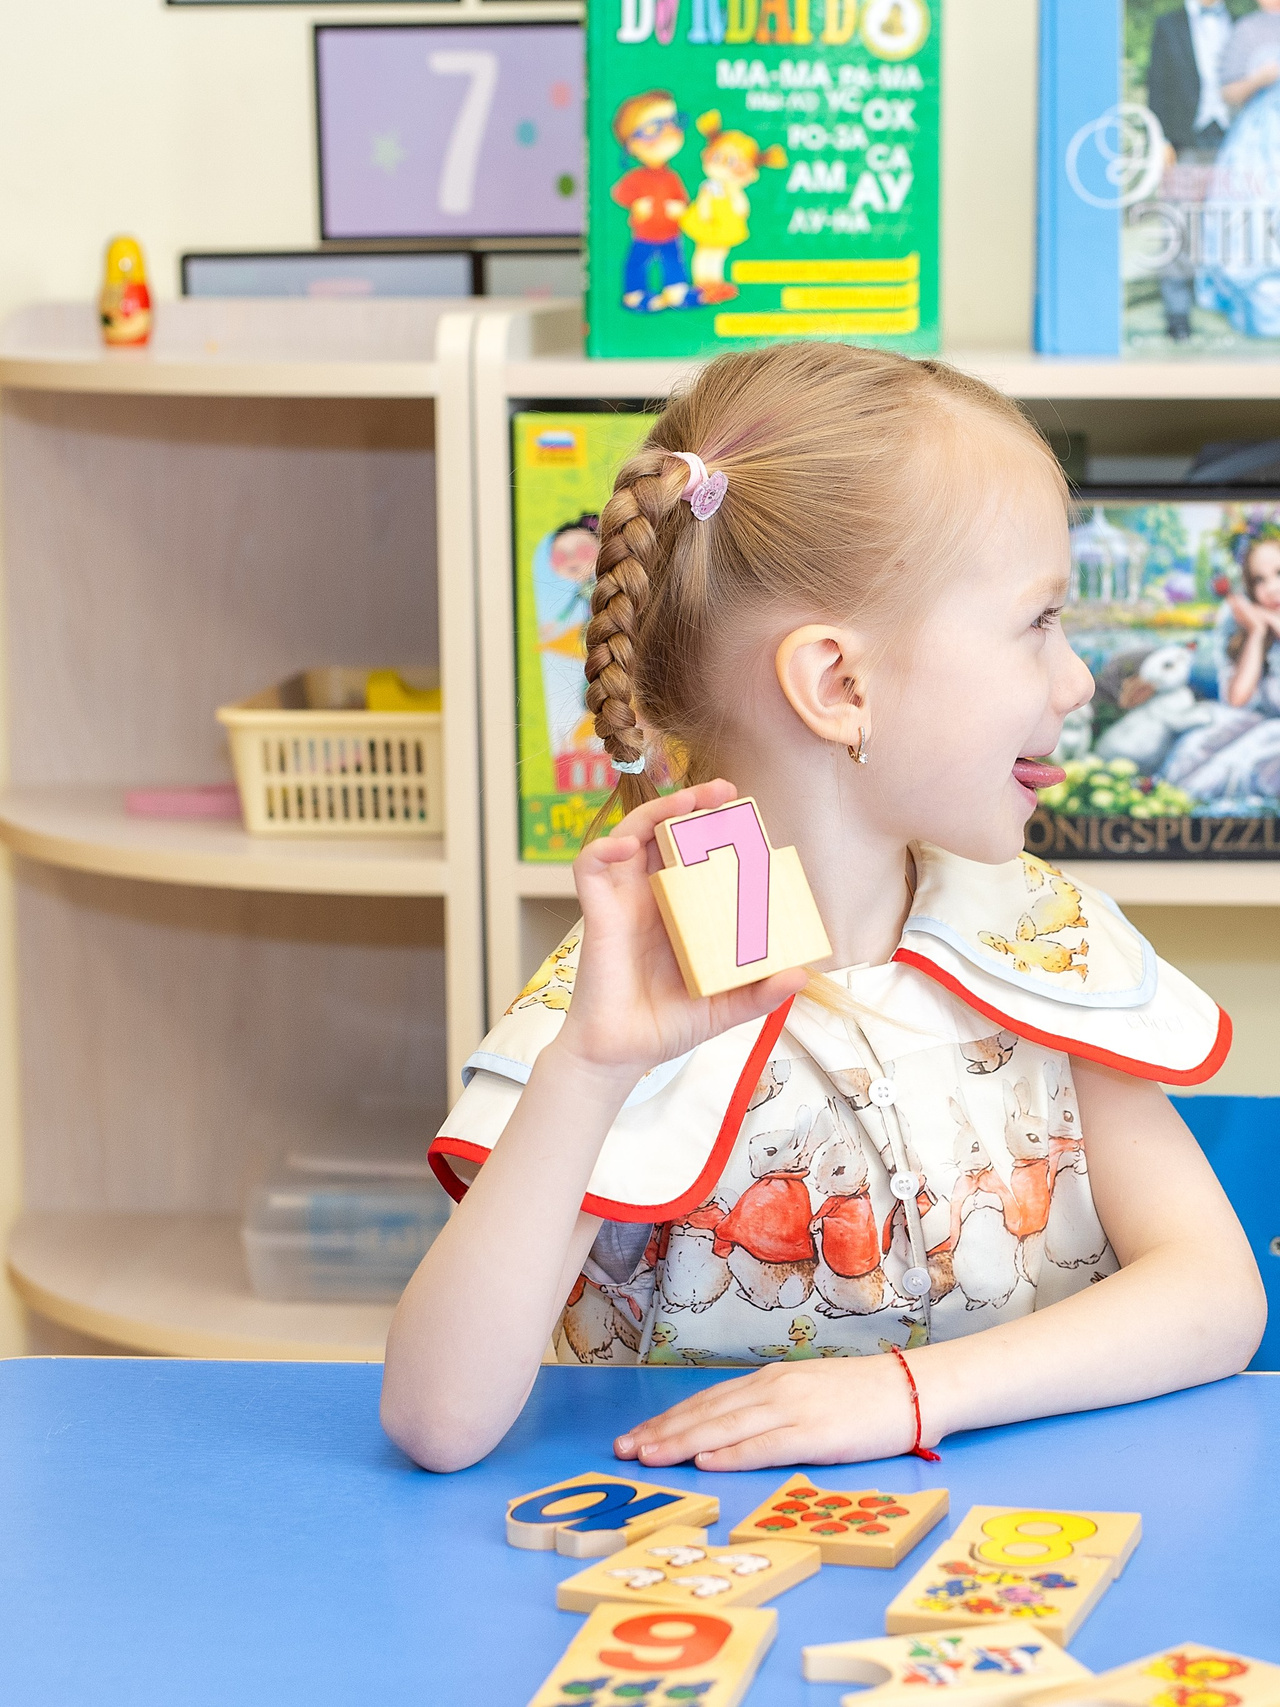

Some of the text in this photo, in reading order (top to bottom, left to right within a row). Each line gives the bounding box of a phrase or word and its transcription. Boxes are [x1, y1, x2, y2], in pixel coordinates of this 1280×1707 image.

[427, 50, 498, 216] 7
[786, 160, 847, 193] АМ
[849, 170, 914, 213] АУ
[670, 801, 770, 968] 7
[978, 1511, 1098, 1566] 8
[598, 1613, 734, 1672] 9
